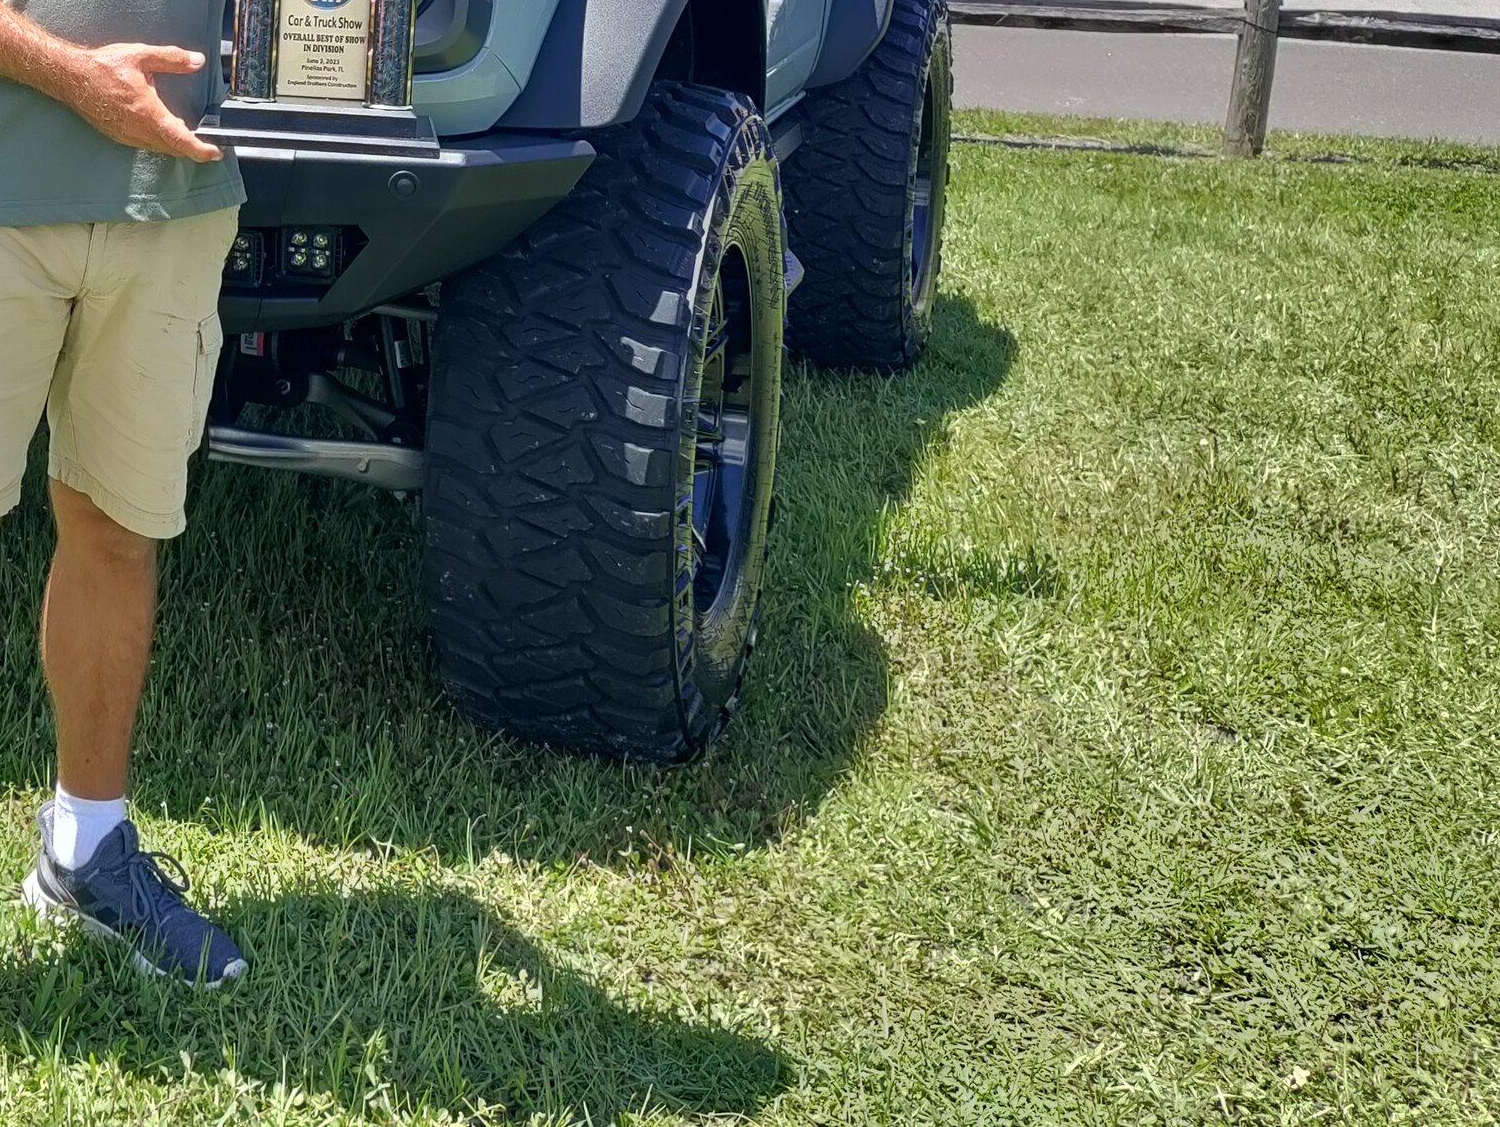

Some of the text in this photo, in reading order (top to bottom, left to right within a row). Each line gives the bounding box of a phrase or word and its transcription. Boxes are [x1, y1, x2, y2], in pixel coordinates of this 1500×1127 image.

[288, 15, 362, 29] Car & Truck Show
[283, 33, 367, 44] OVERALL BEST OF SHOW
[303, 44, 345, 53] IN DIVISION
